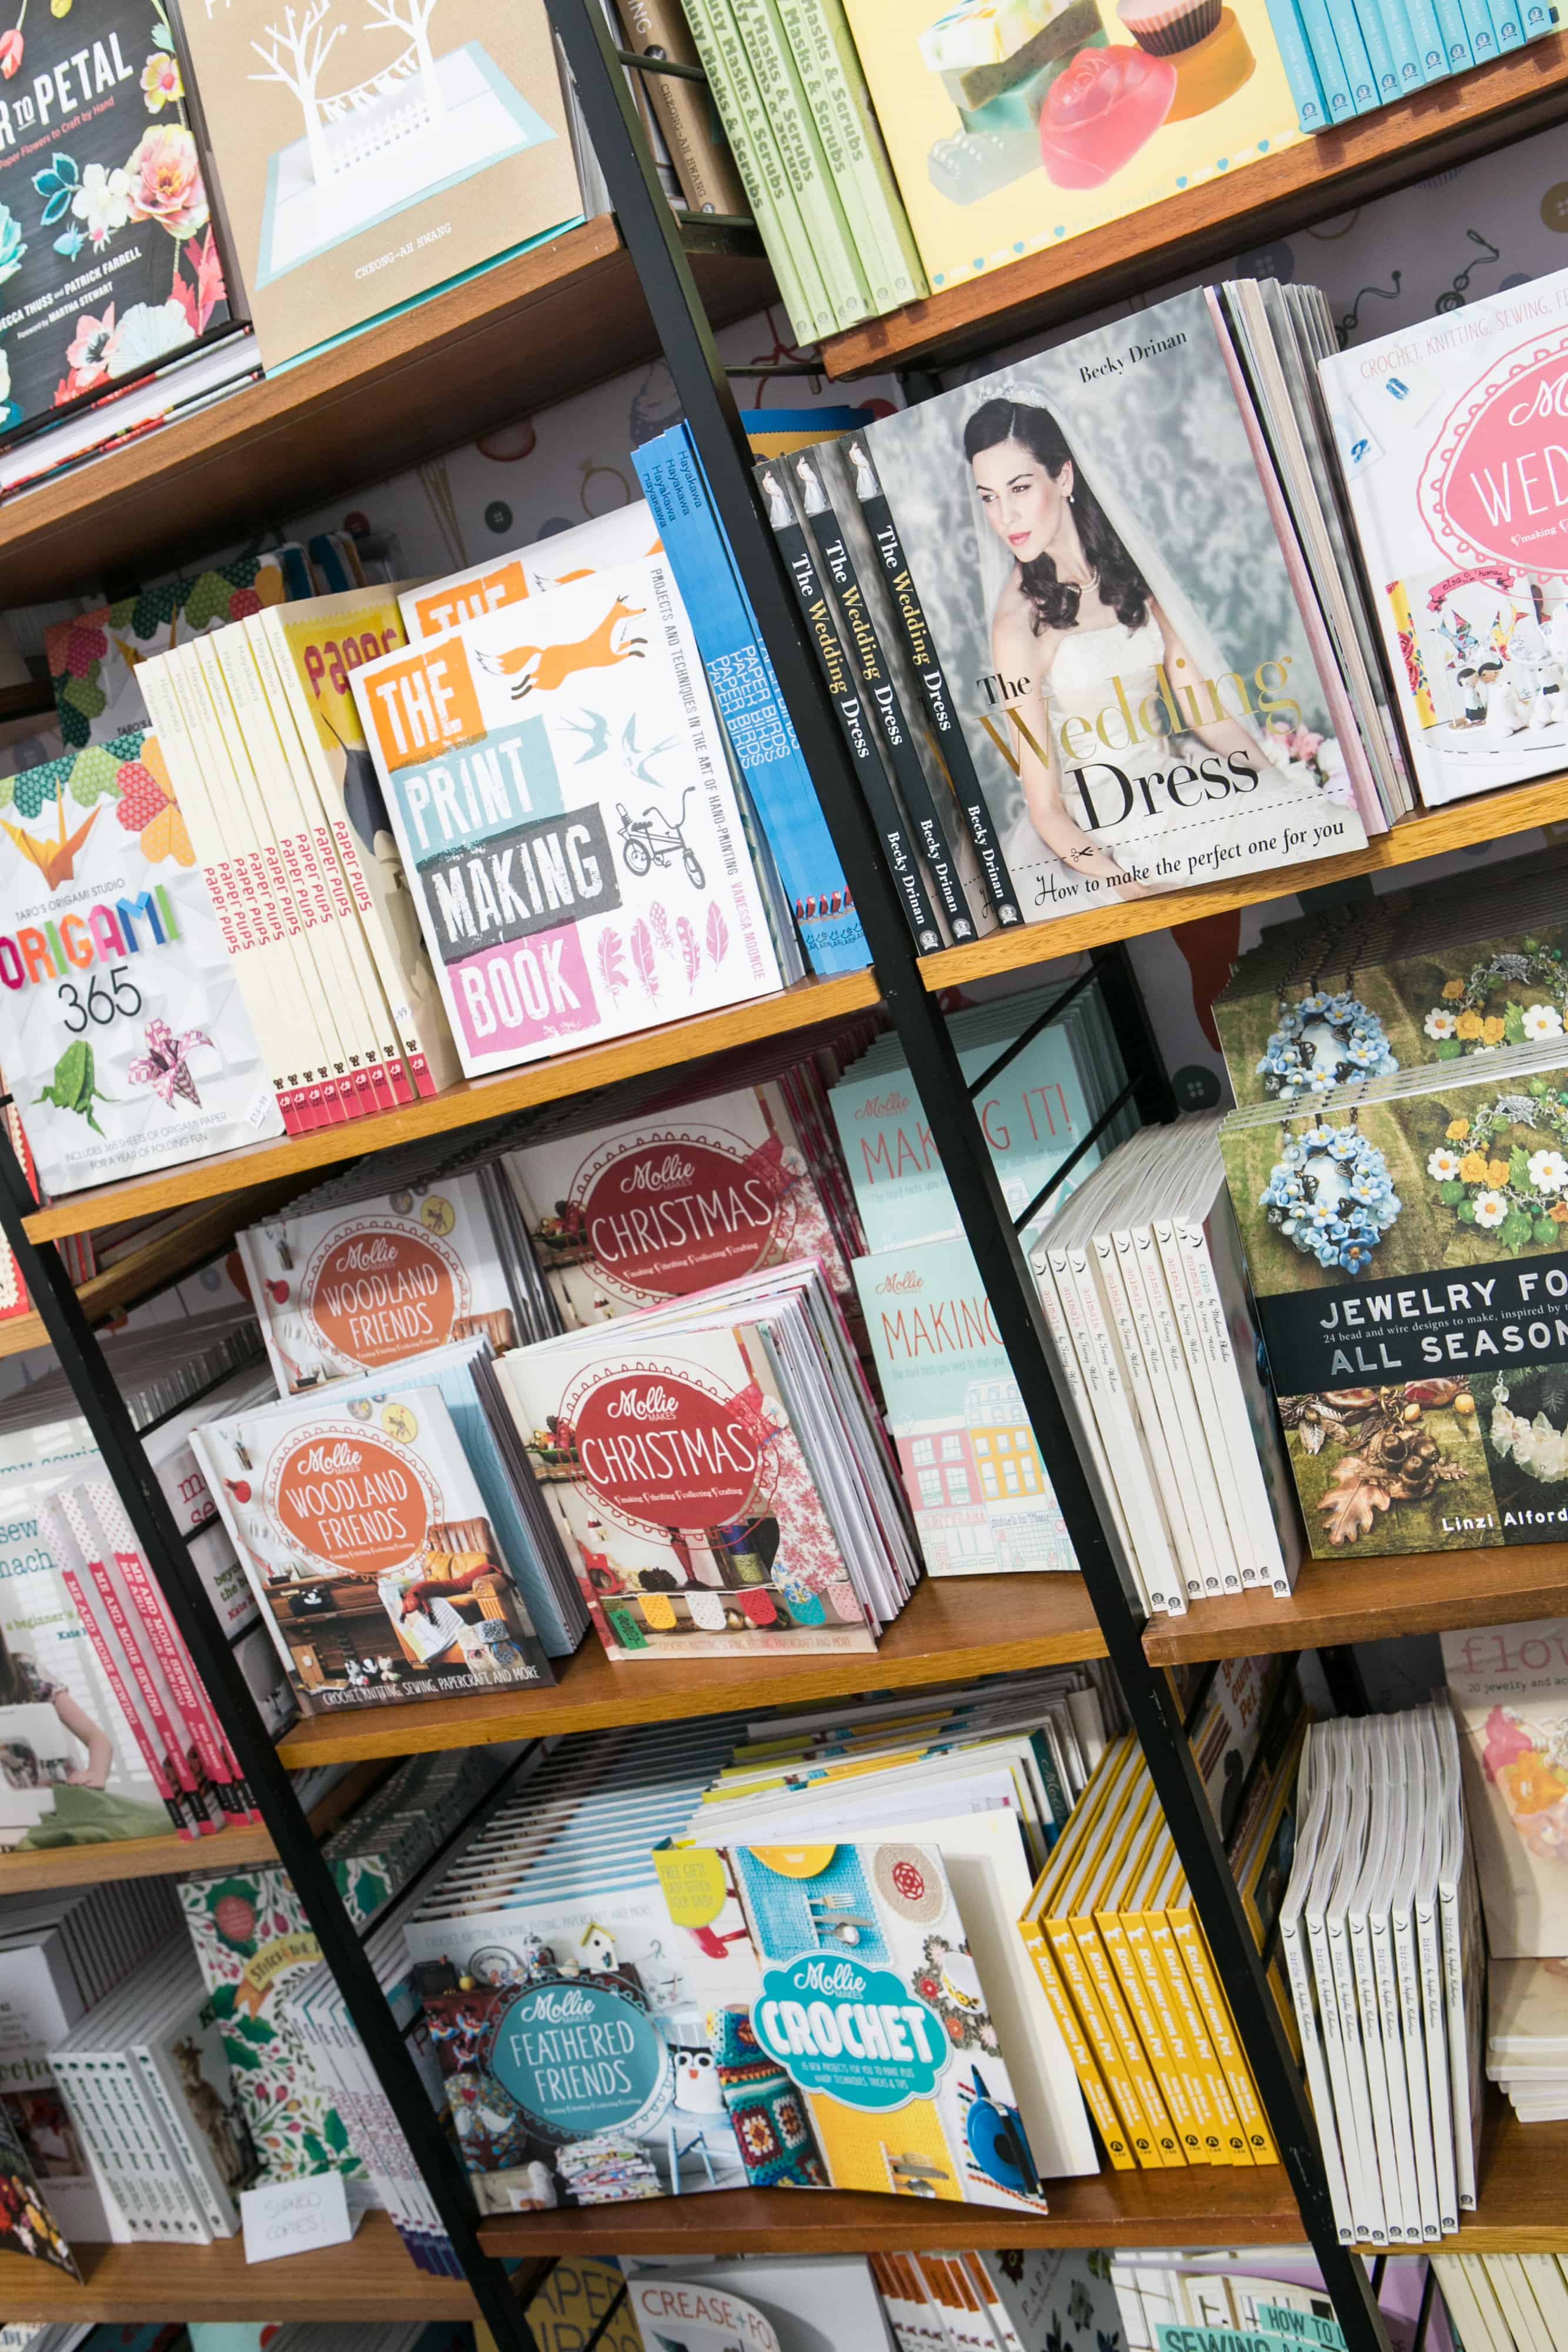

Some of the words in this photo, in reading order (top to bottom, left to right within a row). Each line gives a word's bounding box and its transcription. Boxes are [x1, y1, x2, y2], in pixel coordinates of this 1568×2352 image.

[34, 32, 133, 126] PETAL
[802, 0, 831, 62] Masks
[825, 67, 838, 83] &
[832, 88, 864, 162] Scrubs
[660, 83, 692, 155] CHEONG-AH
[686, 156, 707, 198] HWANG
[702, 46, 730, 112] Masks
[726, 118, 738, 133] &
[733, 137, 763, 209] Scrubs
[723, 36, 751, 103] Masks
[747, 108, 759, 123] &
[754, 128, 784, 199] Scrubs
[355, 242, 414, 279] CHEONG-AH
[416, 222, 452, 252] HWANG
[24, 293, 54, 316] THUSS
[64, 267, 102, 295] PATRICK
[102, 246, 142, 275] FARRELL
[48, 300, 80, 323] MARTHA
[79, 281, 113, 307] STEWART
[1079, 355, 1125, 384] Becky
[1128, 331, 1188, 365] Drinan
[1360, 344, 1423, 379] CROCHET,
[1426, 320, 1492, 355] KNITTING,
[1496, 297, 1552, 331] SEWING,
[666, 458, 690, 516] Hayakawa
[678, 450, 701, 509] Hayakawa
[1520, 527, 1558, 544] making
[650, 569, 673, 622] PROJECTS
[664, 625, 680, 646] AND
[376, 659, 462, 754] THE
[670, 649, 697, 714] TECHNIQUES
[741, 644, 771, 703] PAPER
[762, 704, 790, 758] BIRDS
[976, 673, 1033, 706] The
[688, 716, 701, 729] IN
[716, 656, 745, 712] PAPER
[737, 714, 764, 766] BIRDS
[877, 524, 898, 569] The
[892, 570, 931, 666] Wedding
[922, 670, 951, 731] Dress
[968, 804, 987, 847] Becky
[982, 848, 1004, 899] Drinan
[973, 656, 1303, 778] Wedding
[691, 730, 708, 752] THE
[698, 757, 714, 774] ART
[791, 553, 814, 598] The
[808, 599, 848, 694] Wedding
[841, 697, 870, 759] Dress
[887, 831, 908, 874] Becky
[902, 874, 925, 926] Drinan
[403, 737, 533, 850] PRINT
[704, 779, 718, 792] OF
[1065, 750, 1259, 833] Dress
[708, 795, 738, 876] HAND-PRINTING
[432, 824, 603, 942] MAKING
[1034, 876, 1078, 907] How
[1085, 876, 1101, 893] to
[1106, 866, 1151, 889] make
[1156, 857, 1182, 877] the
[1188, 843, 1243, 874] perfect
[1248, 837, 1278, 856] one
[1282, 827, 1308, 854] for
[1313, 821, 1345, 847] you
[15, 904, 47, 922] TARO'S
[48, 890, 91, 911] ORIGAMI
[91, 878, 125, 897] STUDIO
[0, 884, 179, 990] ORIGAMI
[731, 881, 753, 930] VANESSA
[743, 931, 765, 980] MOONCIE
[59, 965, 142, 1033] 365
[461, 940, 581, 1038] BOOK
[200, 1112, 227, 1126] PAPER
[855, 1091, 911, 1120] Mollie
[1023, 1083, 1072, 1141] IT!
[620, 1153, 695, 1194] Mollie
[591, 1180, 773, 1263] CHRISTMAS
[336, 1237, 399, 1272] Mollie
[322, 1263, 439, 1318] WOODLAND
[876, 1271, 925, 1294] Mollie
[1320, 1279, 1496, 1329] JEWELRY
[349, 1302, 433, 1349] FRIENDS
[1323, 1333, 1335, 1344] 24
[1339, 1329, 1362, 1341] bead
[1366, 1326, 1384, 1338] and
[1388, 1324, 1409, 1335] wire
[1413, 1319, 1449, 1333] designs
[1453, 1315, 1463, 1325] to
[1467, 1311, 1498, 1324] make,
[1501, 1303, 1544, 1320] inspired
[1547, 1302, 1560, 1315] by
[1331, 1342, 1402, 1375] ALL
[608, 1385, 679, 1421] Mollie
[648, 1409, 677, 1422] MAKES
[297, 1442, 362, 1475] Mollie
[581, 1424, 755, 1485] CHRISTMAS
[286, 1469, 408, 1519] WOODLAND
[1442, 1510, 1493, 1532] Linzi
[1504, 1509, 1568, 1526] Alford
[317, 1508, 407, 1551] FRIENDS
[95, 1571, 108, 1588] ME
[103, 1589, 122, 1625] AND
[118, 1628, 140, 1665] MORE
[135, 1667, 162, 1716] SEWING
[130, 1562, 143, 1579] ME
[141, 1580, 158, 1614] AND
[153, 1616, 174, 1655] MORE
[169, 1659, 197, 1708] SEWING
[493, 1671, 512, 1683] AND
[513, 1665, 540, 1679] MORE
[1531, 1677, 1551, 1688] and
[521, 1989, 596, 2024] Mollie
[794, 1962, 867, 1997] Mollie
[1037, 1956, 1057, 1986] Knit
[1047, 1986, 1068, 2017] your
[1062, 2017, 1078, 2044] own
[1185, 1945, 1204, 1975] Knit
[1195, 1976, 1216, 2005] your
[1208, 2006, 1223, 2033] own
[509, 2020, 635, 2069] FEATHERED
[762, 2000, 934, 2064] CROCHET
[534, 2060, 631, 2104] FRIENDS
[641, 2289, 738, 2331] CREASE
[1268, 2307, 1305, 2335] HOW
[1311, 2318, 1333, 2343] TO
